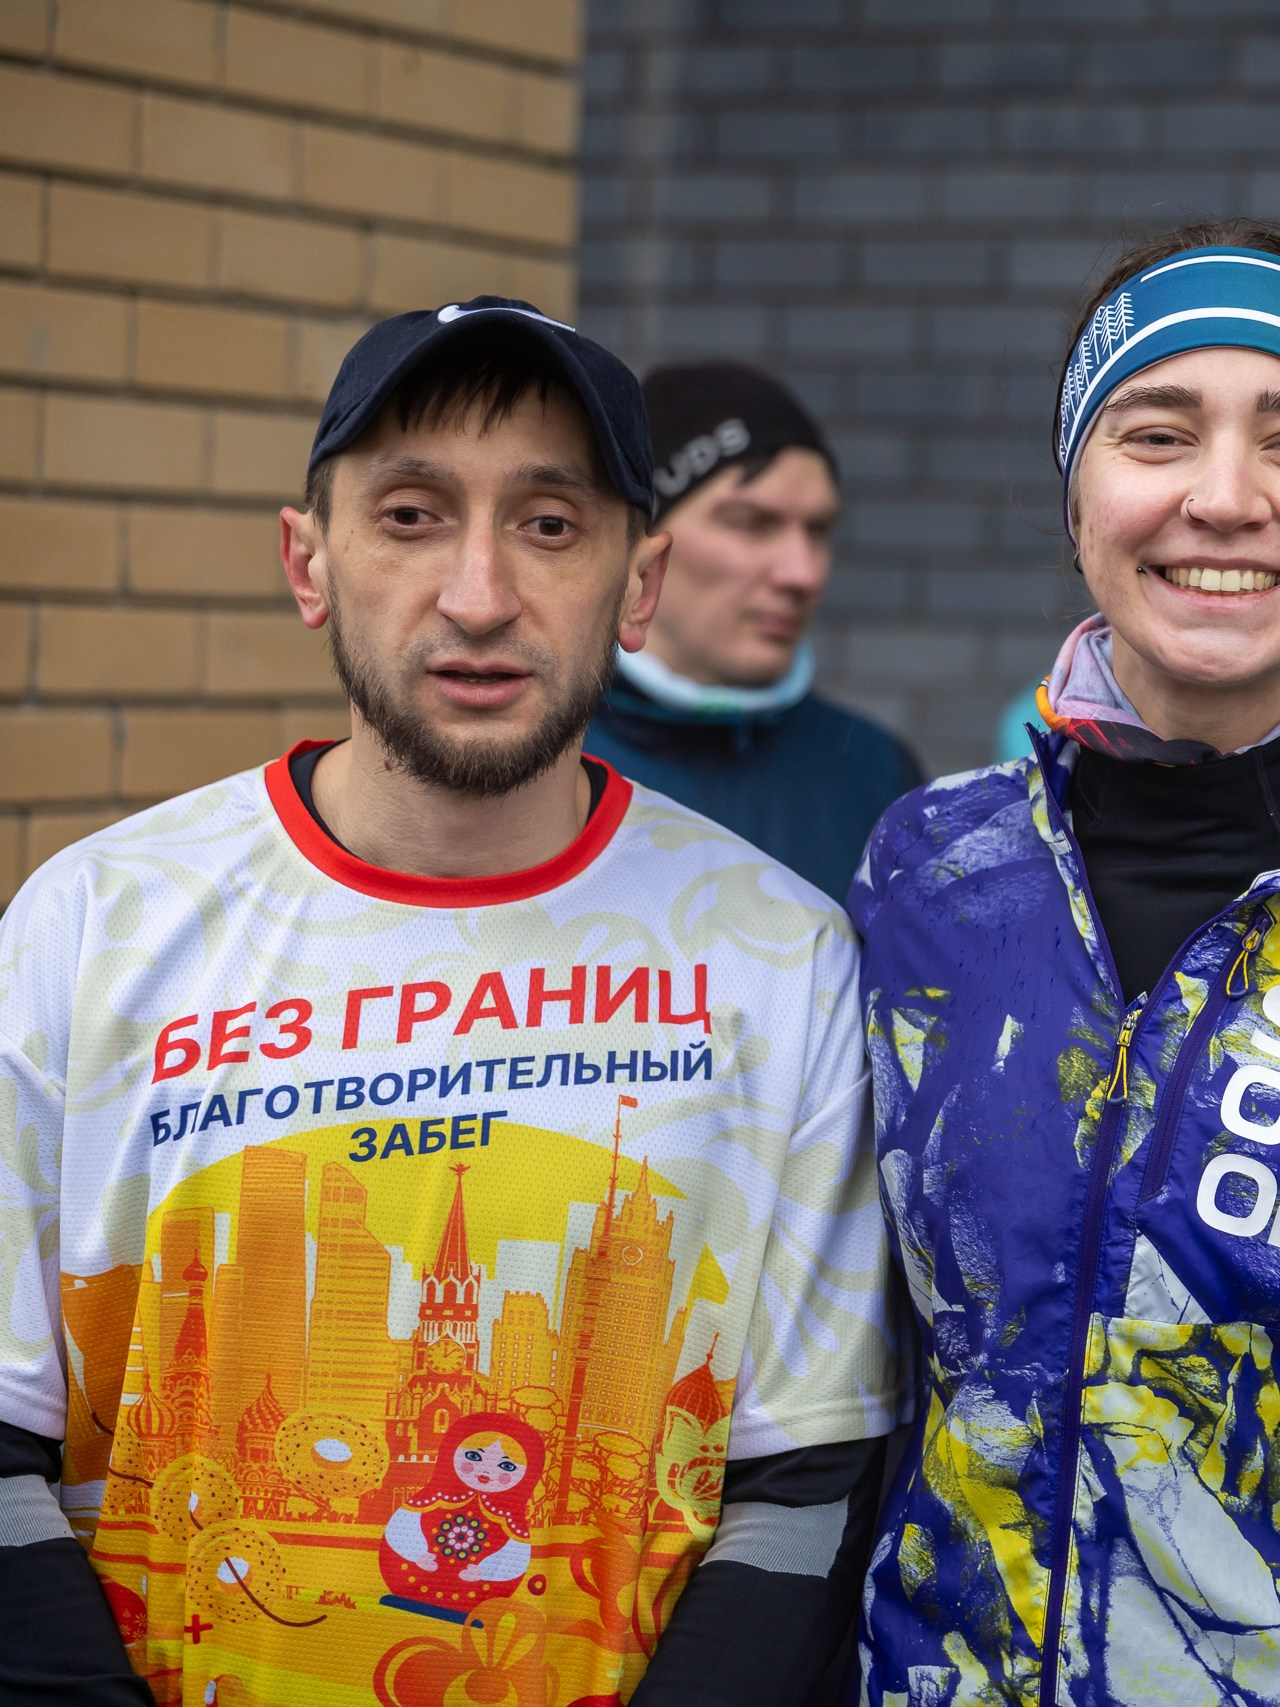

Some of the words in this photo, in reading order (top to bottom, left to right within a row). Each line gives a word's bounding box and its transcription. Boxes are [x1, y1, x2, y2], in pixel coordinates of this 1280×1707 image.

[151, 996, 314, 1084] БЕЗ
[341, 963, 713, 1050] ГРАНИЦ
[150, 1040, 713, 1146] БЛАГОТВОРИТЕЛЬНЫЙ
[348, 1109, 508, 1163] ЗАБЕГ
